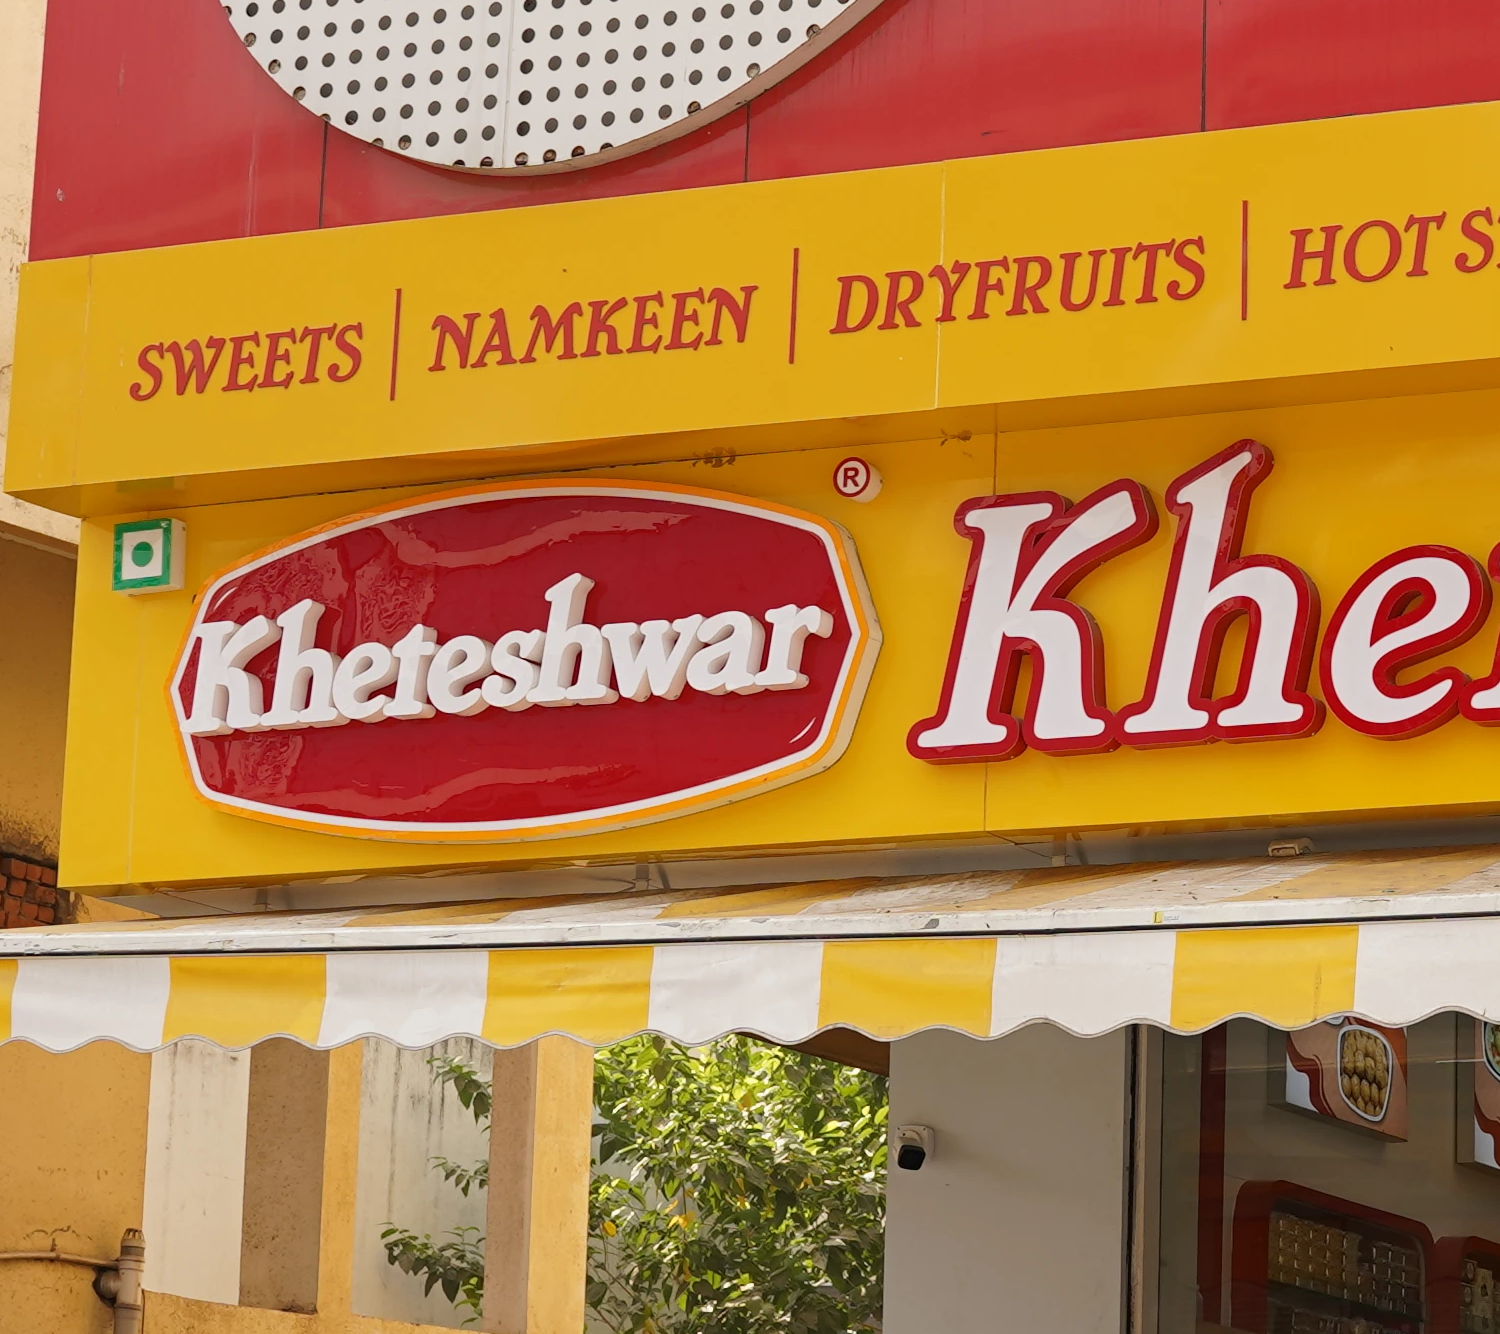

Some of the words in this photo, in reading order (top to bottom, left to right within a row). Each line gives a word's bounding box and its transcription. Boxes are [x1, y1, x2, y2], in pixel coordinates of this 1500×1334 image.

[830, 236, 1207, 336] DRYFRUITS
[1282, 211, 1450, 289] HOT
[129, 322, 363, 401] SWEETS
[428, 286, 757, 371] NAMKEEN
[182, 573, 834, 736] Kheteshwar
